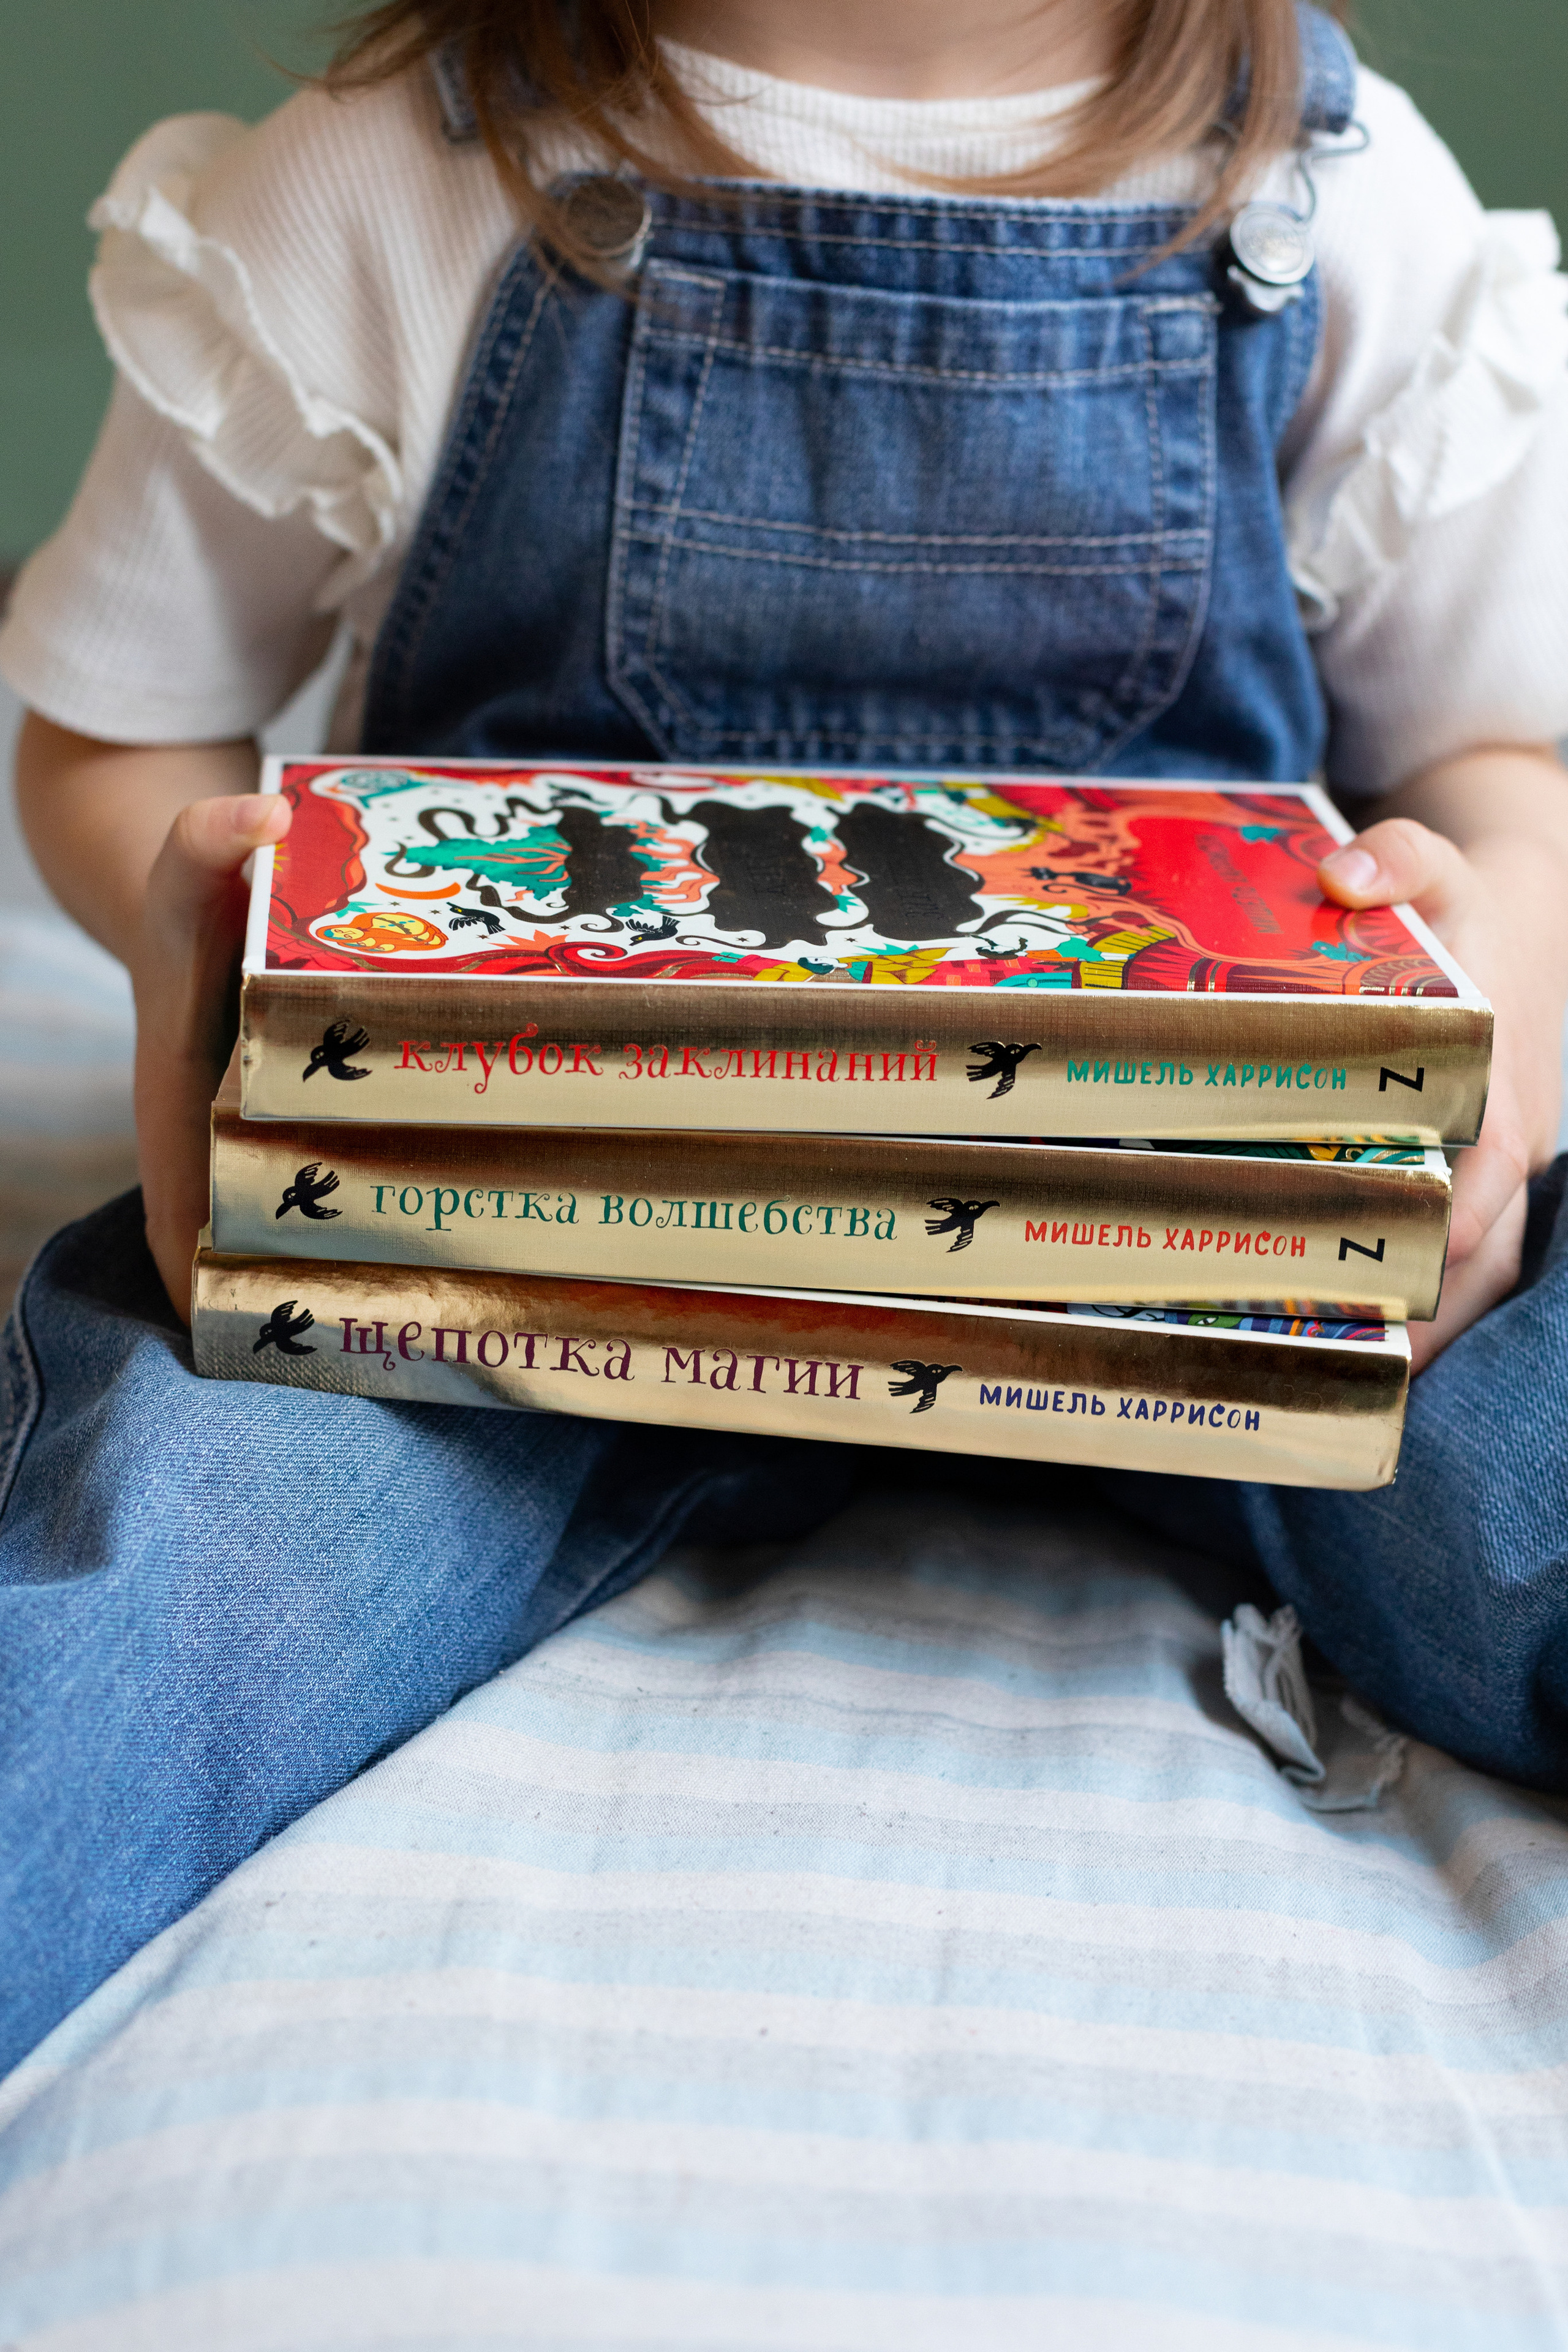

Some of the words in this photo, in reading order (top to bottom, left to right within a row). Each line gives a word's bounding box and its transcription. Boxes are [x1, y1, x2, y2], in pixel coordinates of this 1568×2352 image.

[394, 1022, 603, 1094] клубок
[619, 1039, 940, 1082] заклинаний
[1066, 1060, 1194, 1086] МИШЕЛЬ
[1204, 1063, 1347, 1090] ХАРРИСОН
[369, 1185, 579, 1232] горстка
[598, 1195, 898, 1240] волшебства
[1025, 1220, 1152, 1248] МИШЕЛЬ
[1163, 1228, 1306, 1257] ХАРРИСОН
[339, 1317, 635, 1382] щепотка
[661, 1346, 864, 1400] магии
[979, 1384, 1106, 1415] МИШЕЛЬ
[1117, 1397, 1260, 1431] ХАРРИСОН
